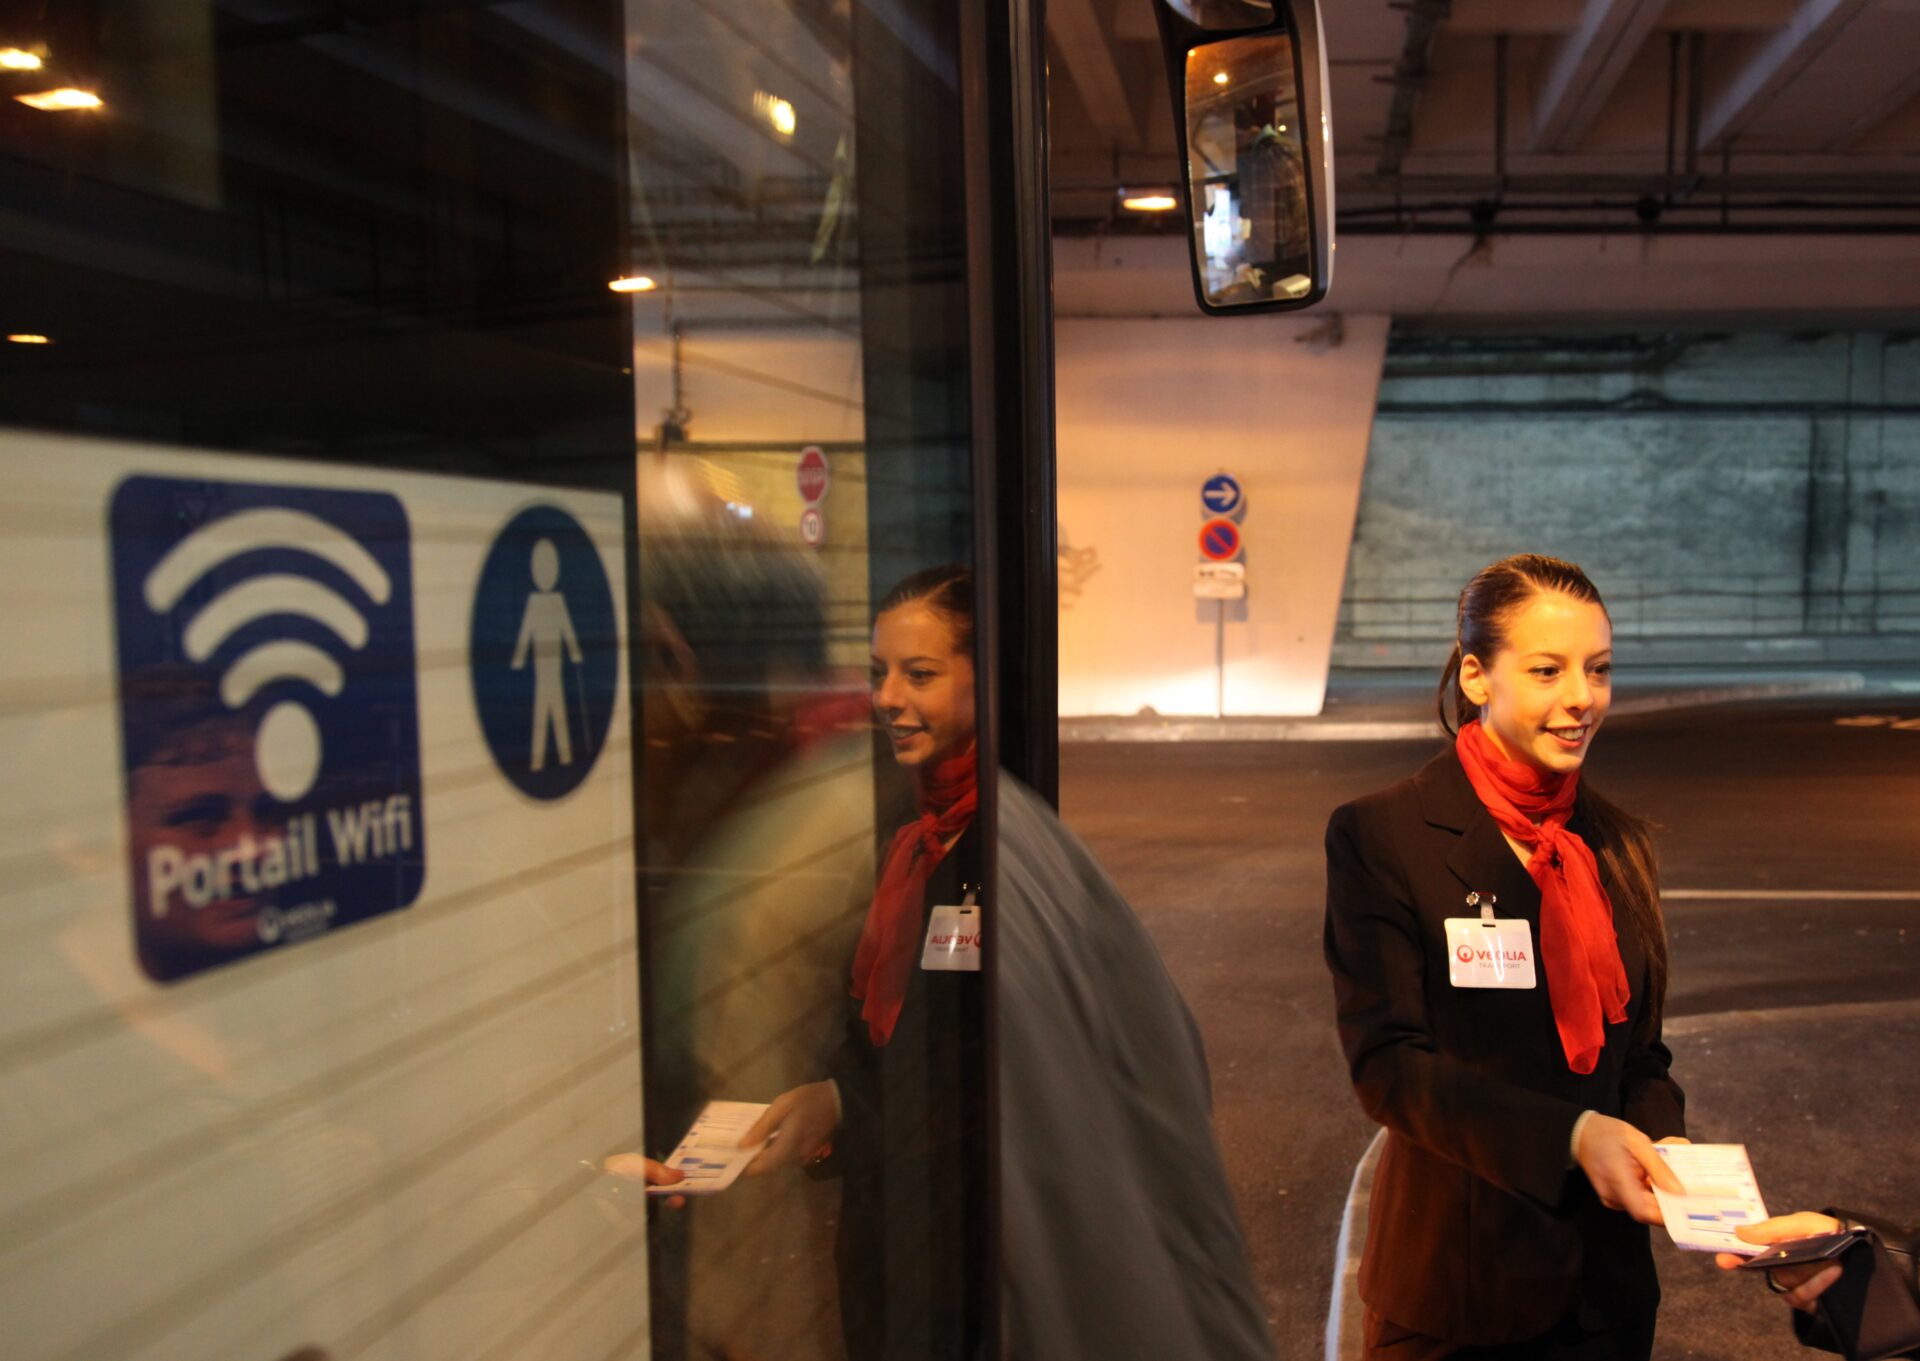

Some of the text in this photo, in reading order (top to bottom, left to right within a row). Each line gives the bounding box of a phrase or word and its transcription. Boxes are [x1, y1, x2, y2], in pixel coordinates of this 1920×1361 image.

[147, 794, 413, 918] Portail Wifi
[1476, 950, 1527, 961] VEOLIA
